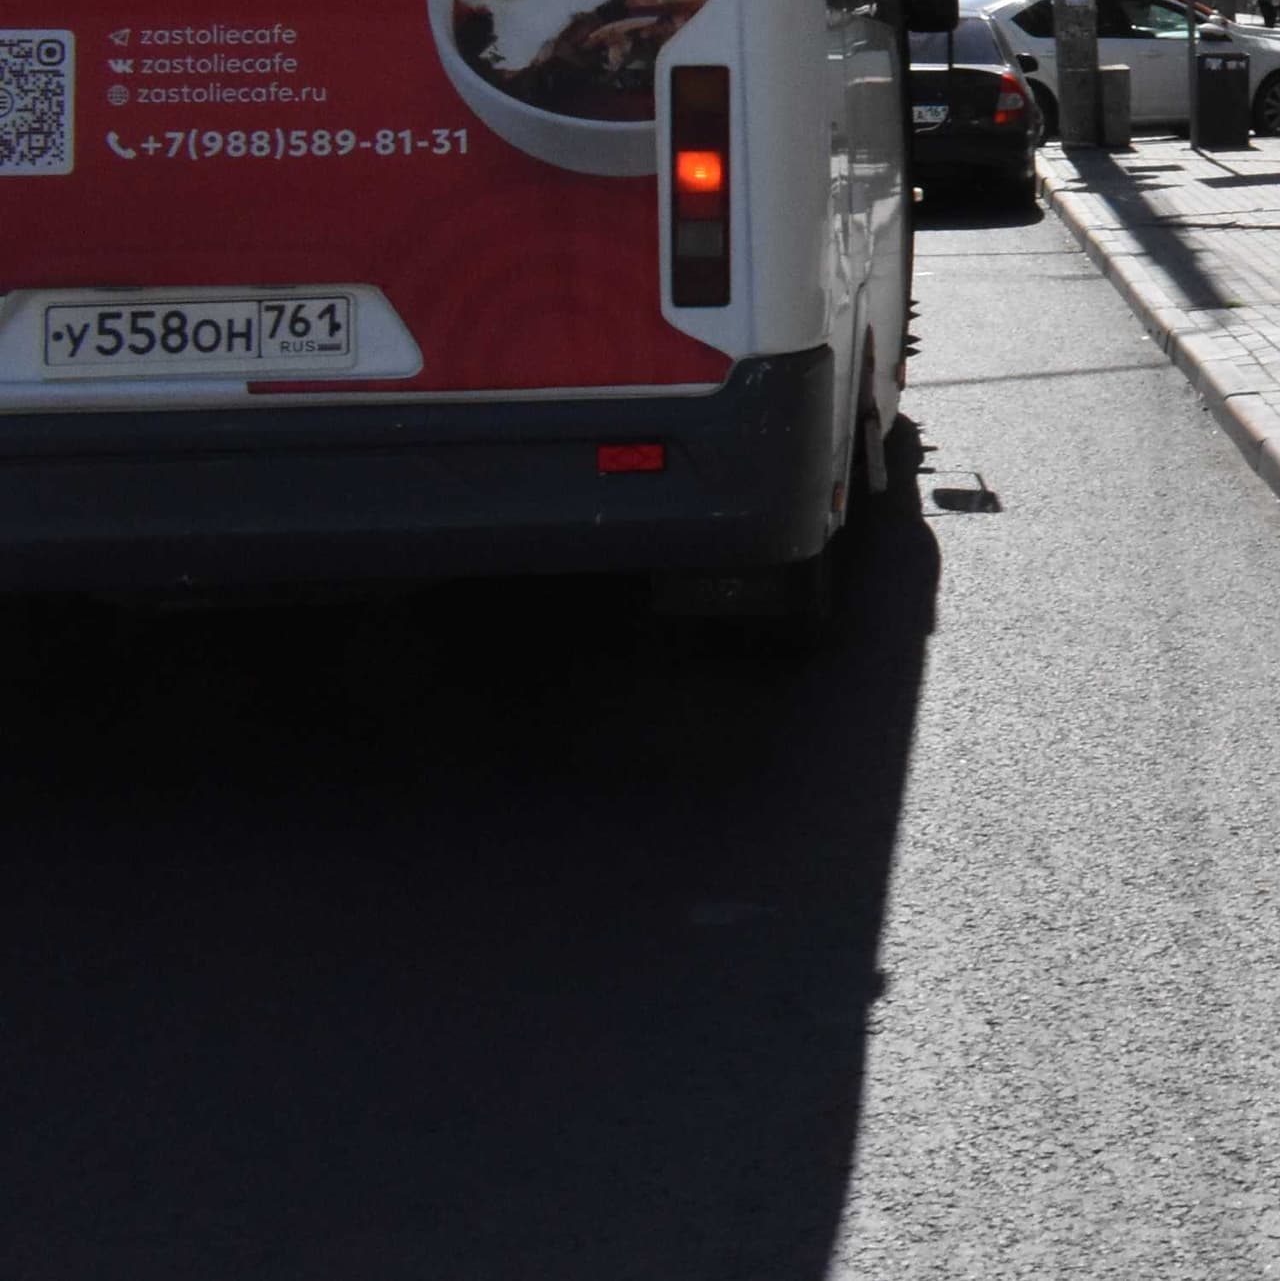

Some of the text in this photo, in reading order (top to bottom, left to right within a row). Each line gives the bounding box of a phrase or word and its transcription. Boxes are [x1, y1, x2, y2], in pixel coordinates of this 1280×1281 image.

[140, 24, 297, 45] zastoliecafe
[141, 53, 298, 74] zastoliecafe
[137, 82, 327, 104] zastoliecafe.ru
[141, 128, 469, 160] +7(988)589-81-31
[263, 303, 341, 339] 761
[280, 340, 316, 353] RUS
